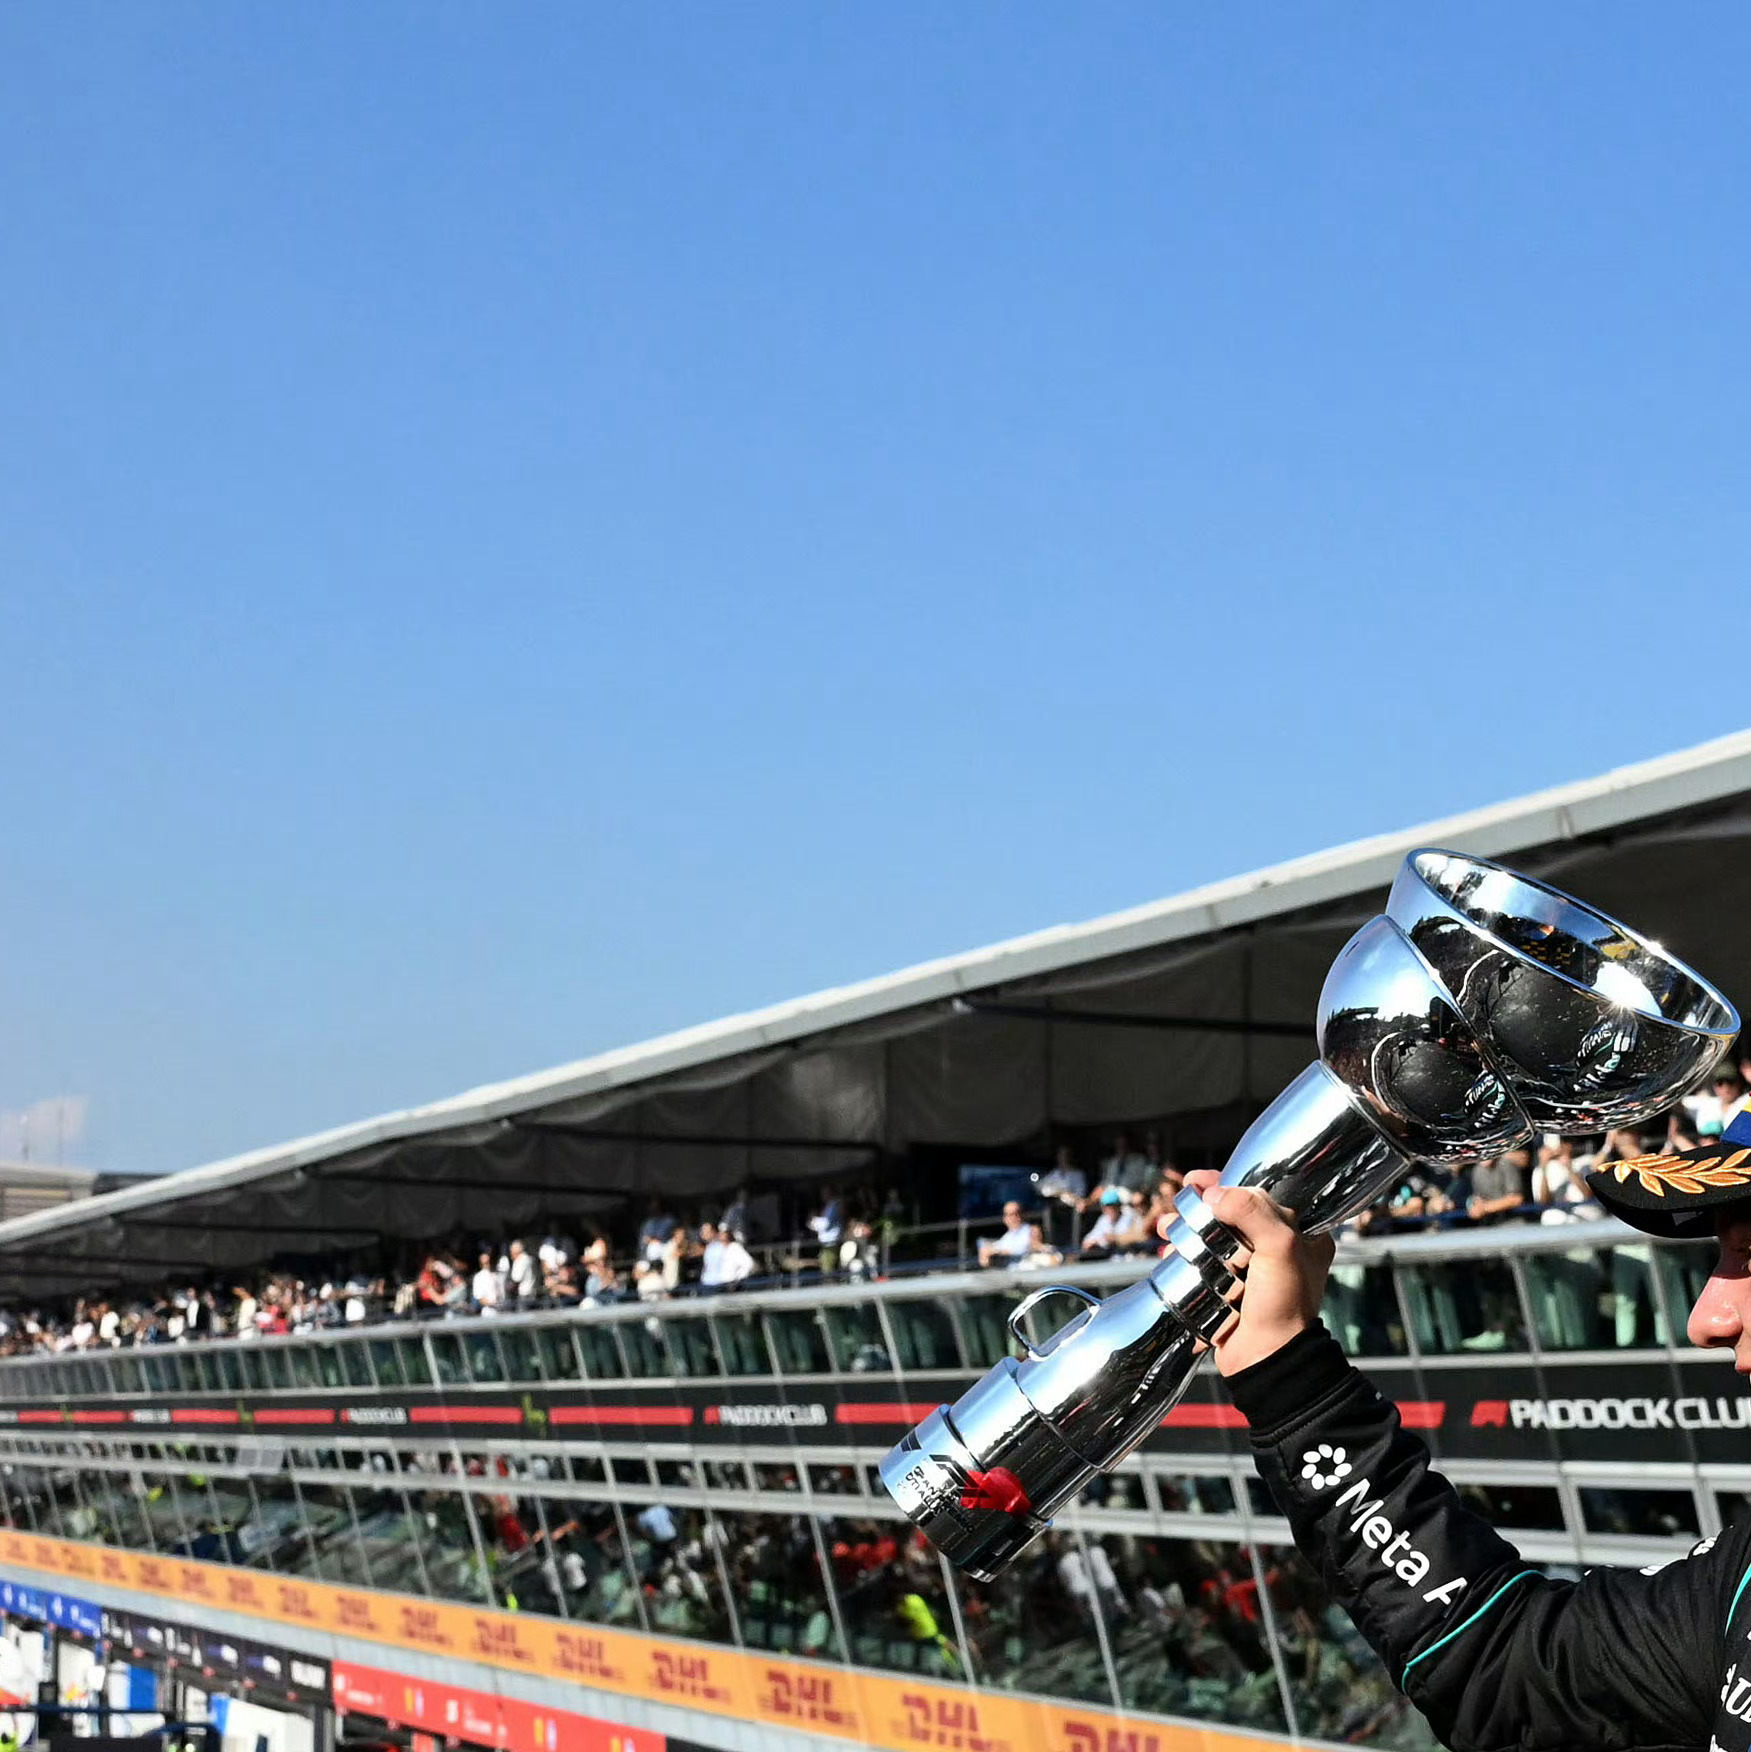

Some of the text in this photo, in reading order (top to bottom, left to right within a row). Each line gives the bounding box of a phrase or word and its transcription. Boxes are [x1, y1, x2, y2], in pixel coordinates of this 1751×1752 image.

[1509, 1397, 1676, 1428] PADDOCK
[1335, 1478, 1431, 1588] Meta
[651, 1650, 718, 1699] DHL
[766, 1669, 843, 1725] DHL
[901, 1694, 993, 1752] DHL
